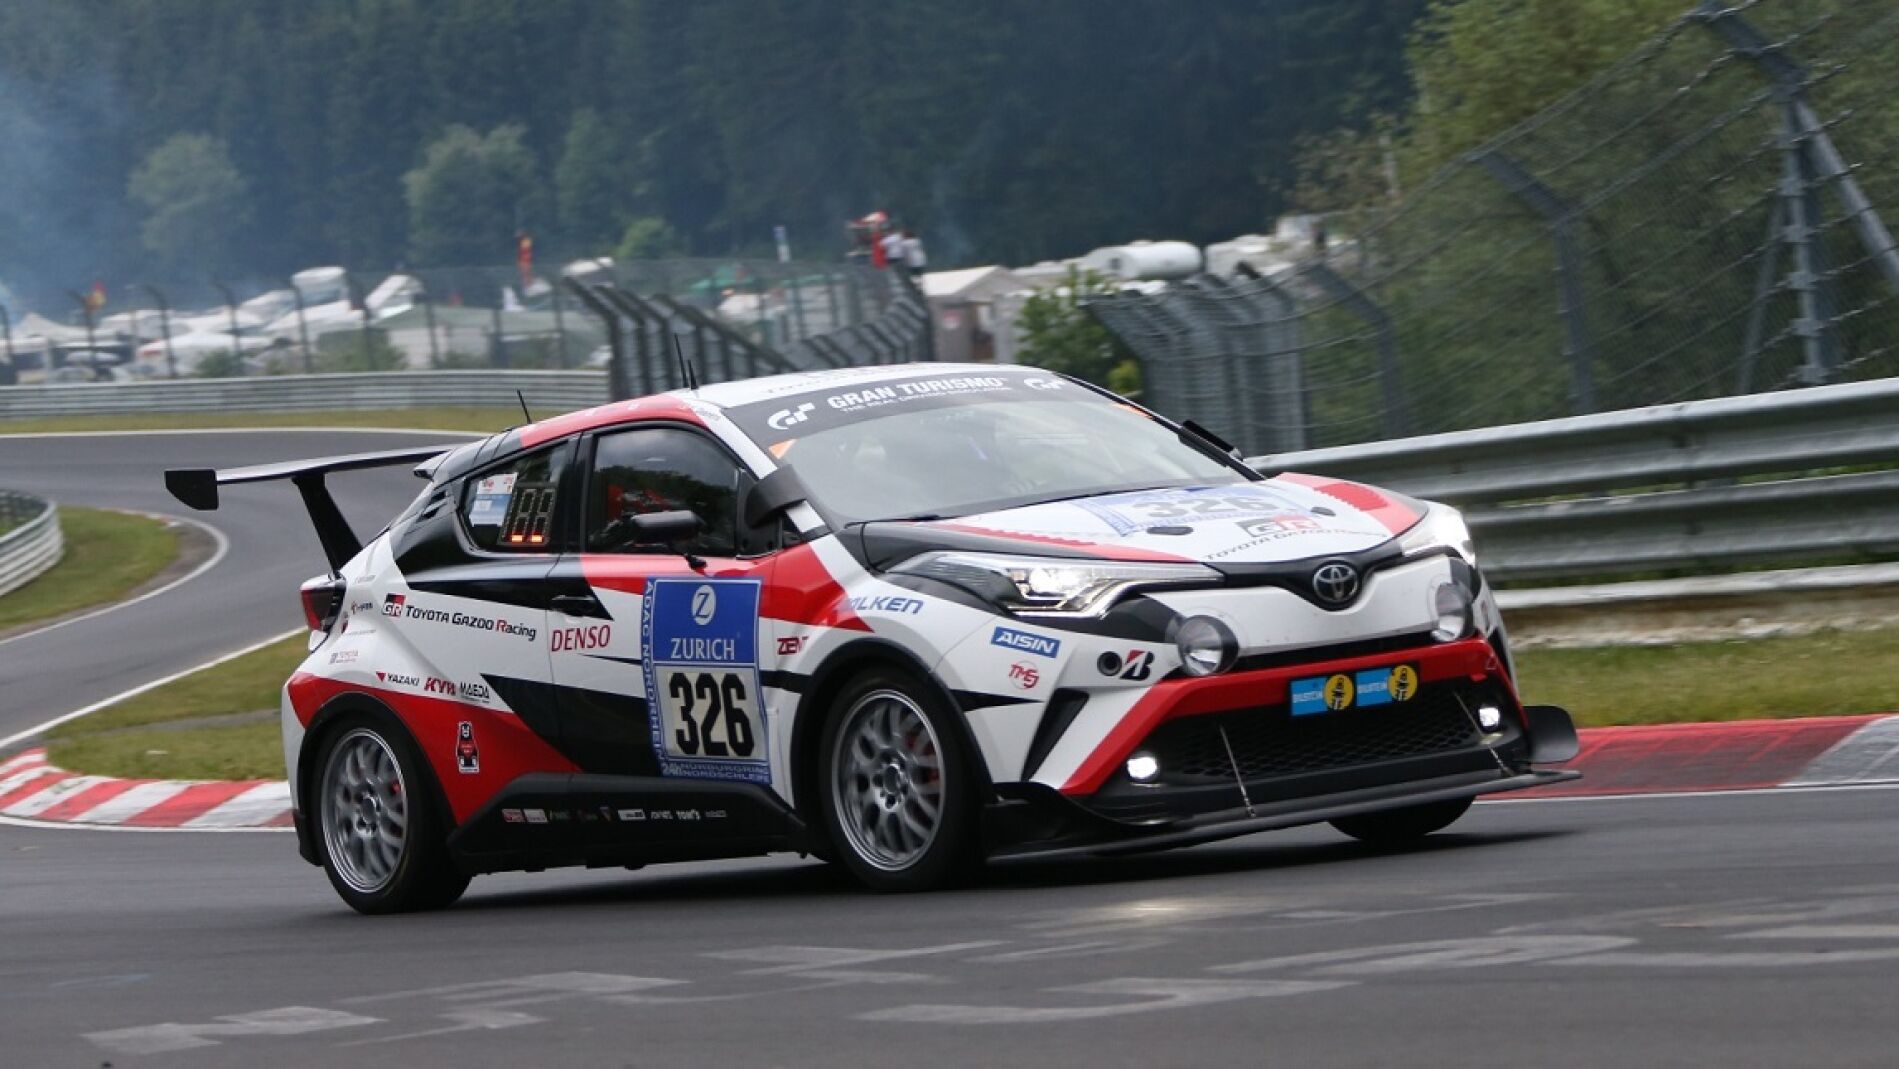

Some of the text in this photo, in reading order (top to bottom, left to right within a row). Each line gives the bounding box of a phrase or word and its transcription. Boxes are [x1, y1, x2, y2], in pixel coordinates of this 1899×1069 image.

[826, 386, 897, 409] GRAN
[896, 378, 1004, 395] TURISMO
[1132, 496, 1278, 518] 326
[1206, 536, 1271, 560] TOYOTA
[382, 601, 403, 617] GR
[642, 580, 653, 636] ADAC
[405, 604, 537, 642] TOYOTA GAZOO Racing
[551, 624, 611, 652] DENSO
[670, 637, 735, 661] ZURICH
[995, 630, 1055, 654] AISIN
[387, 672, 420, 687] YAZAKI
[669, 672, 755, 757] 326
